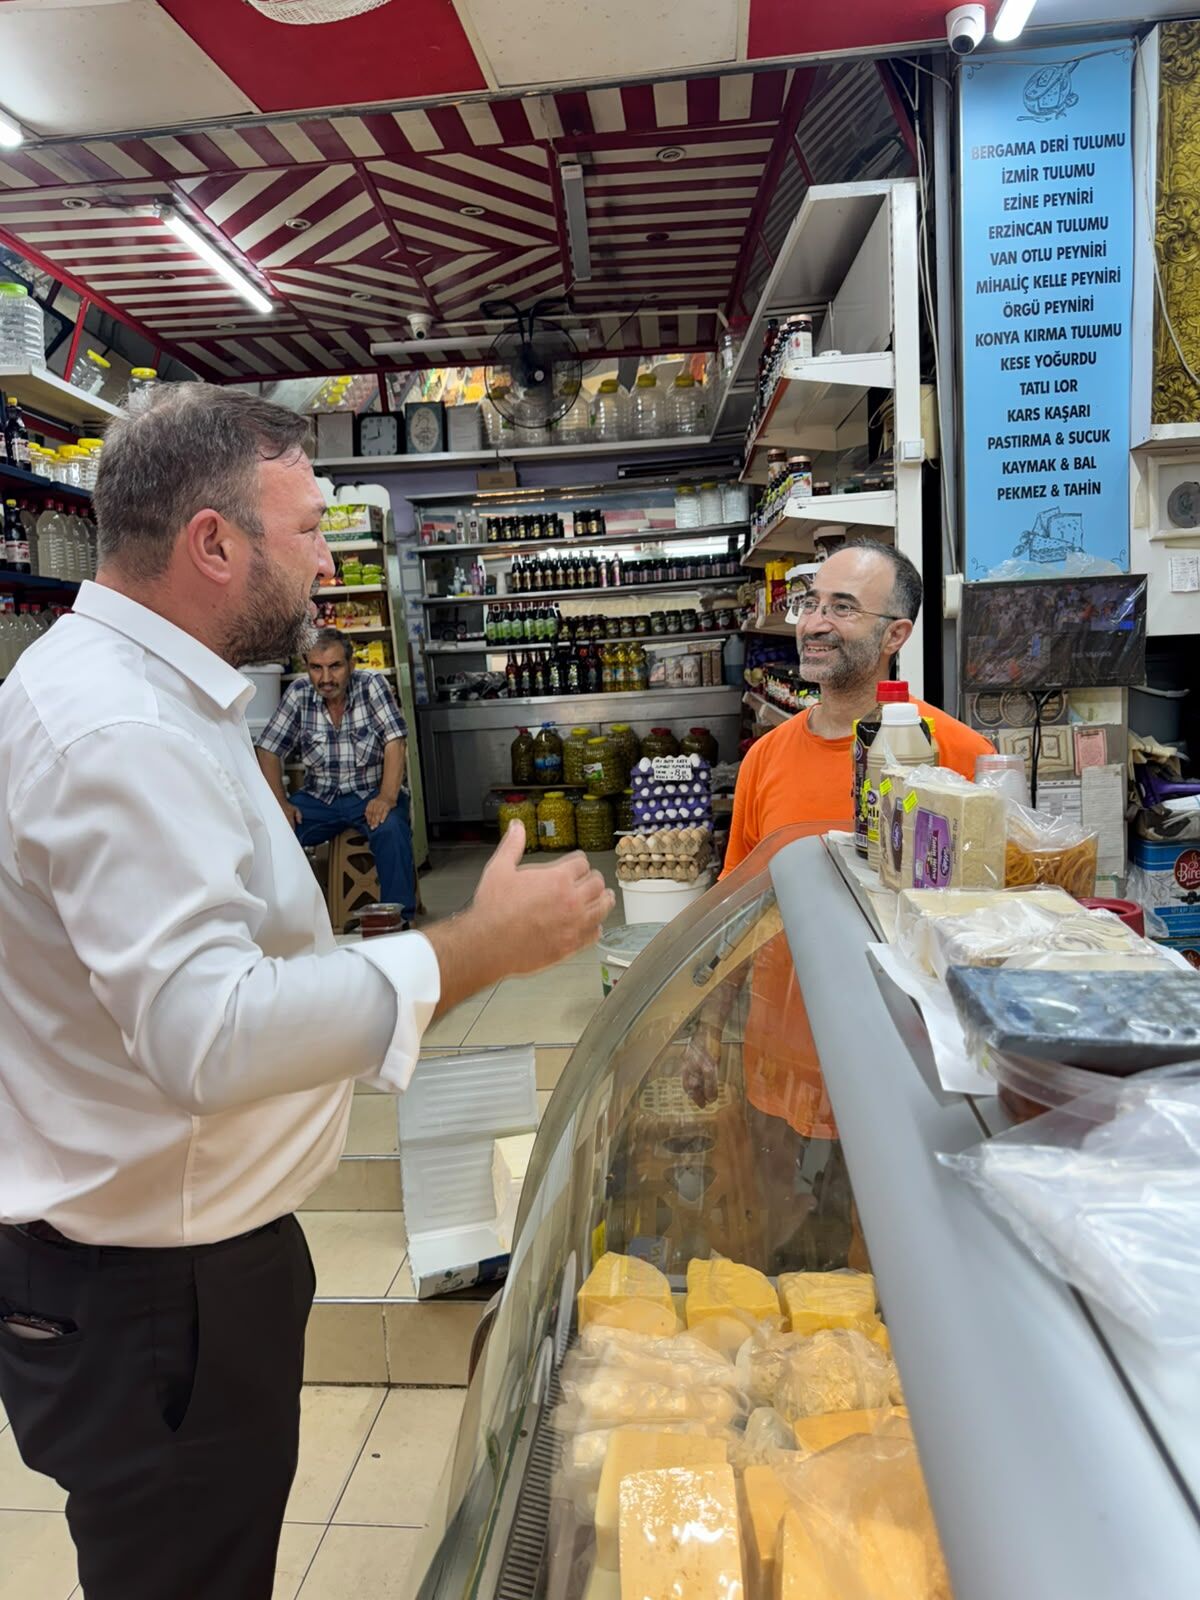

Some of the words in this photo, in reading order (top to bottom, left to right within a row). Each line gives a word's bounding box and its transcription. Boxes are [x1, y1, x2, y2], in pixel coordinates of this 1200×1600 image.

[971, 141, 1036, 159] BERGAMA
[1040, 134, 1068, 153] DERİ
[1072, 133, 1125, 151] TULUMU
[1002, 165, 1039, 184] İZMİR
[1042, 163, 1095, 180] TULUMU
[1004, 193, 1039, 211] EZİNE
[1043, 187, 1093, 207] PEYNİRİ
[989, 219, 1052, 239] ERZİNCAN
[1056, 216, 1108, 233] TULUMU
[990, 251, 1017, 266] VAN
[1021, 248, 1052, 263] OTLU
[1056, 240, 1106, 260] PEYNİRİ
[976, 274, 1029, 294] MİHALİÇ
[1033, 273, 1067, 289] KELLE
[1071, 266, 1121, 286] PEYNİRİ
[1003, 299, 1040, 318] ÖRGÜ
[1044, 295, 1094, 315] PEYNİRİ
[976, 330, 1020, 347] KONYA
[1024, 327, 1067, 343] KIRMA
[1070, 323, 1122, 339] TULUMU
[1001, 356, 1030, 371] KESE
[1034, 350, 1096, 368] YOĞURDU
[1019, 380, 1050, 396] TATLI
[1054, 379, 1078, 393] LOR
[1007, 407, 1041, 423] KARS
[1045, 404, 1090, 423] KAŞARI
[988, 433, 1052, 450] PASTIRMA
[1055, 432, 1064, 445] &
[1068, 429, 1110, 445] SUCUK
[1002, 458, 1056, 475] KAYMAK
[1060, 457, 1070, 471] &
[1073, 456, 1097, 470] BAL
[997, 485, 1047, 500] PEKMEZ
[1051, 484, 1060, 497] &
[1063, 479, 1101, 496] TAHİN
